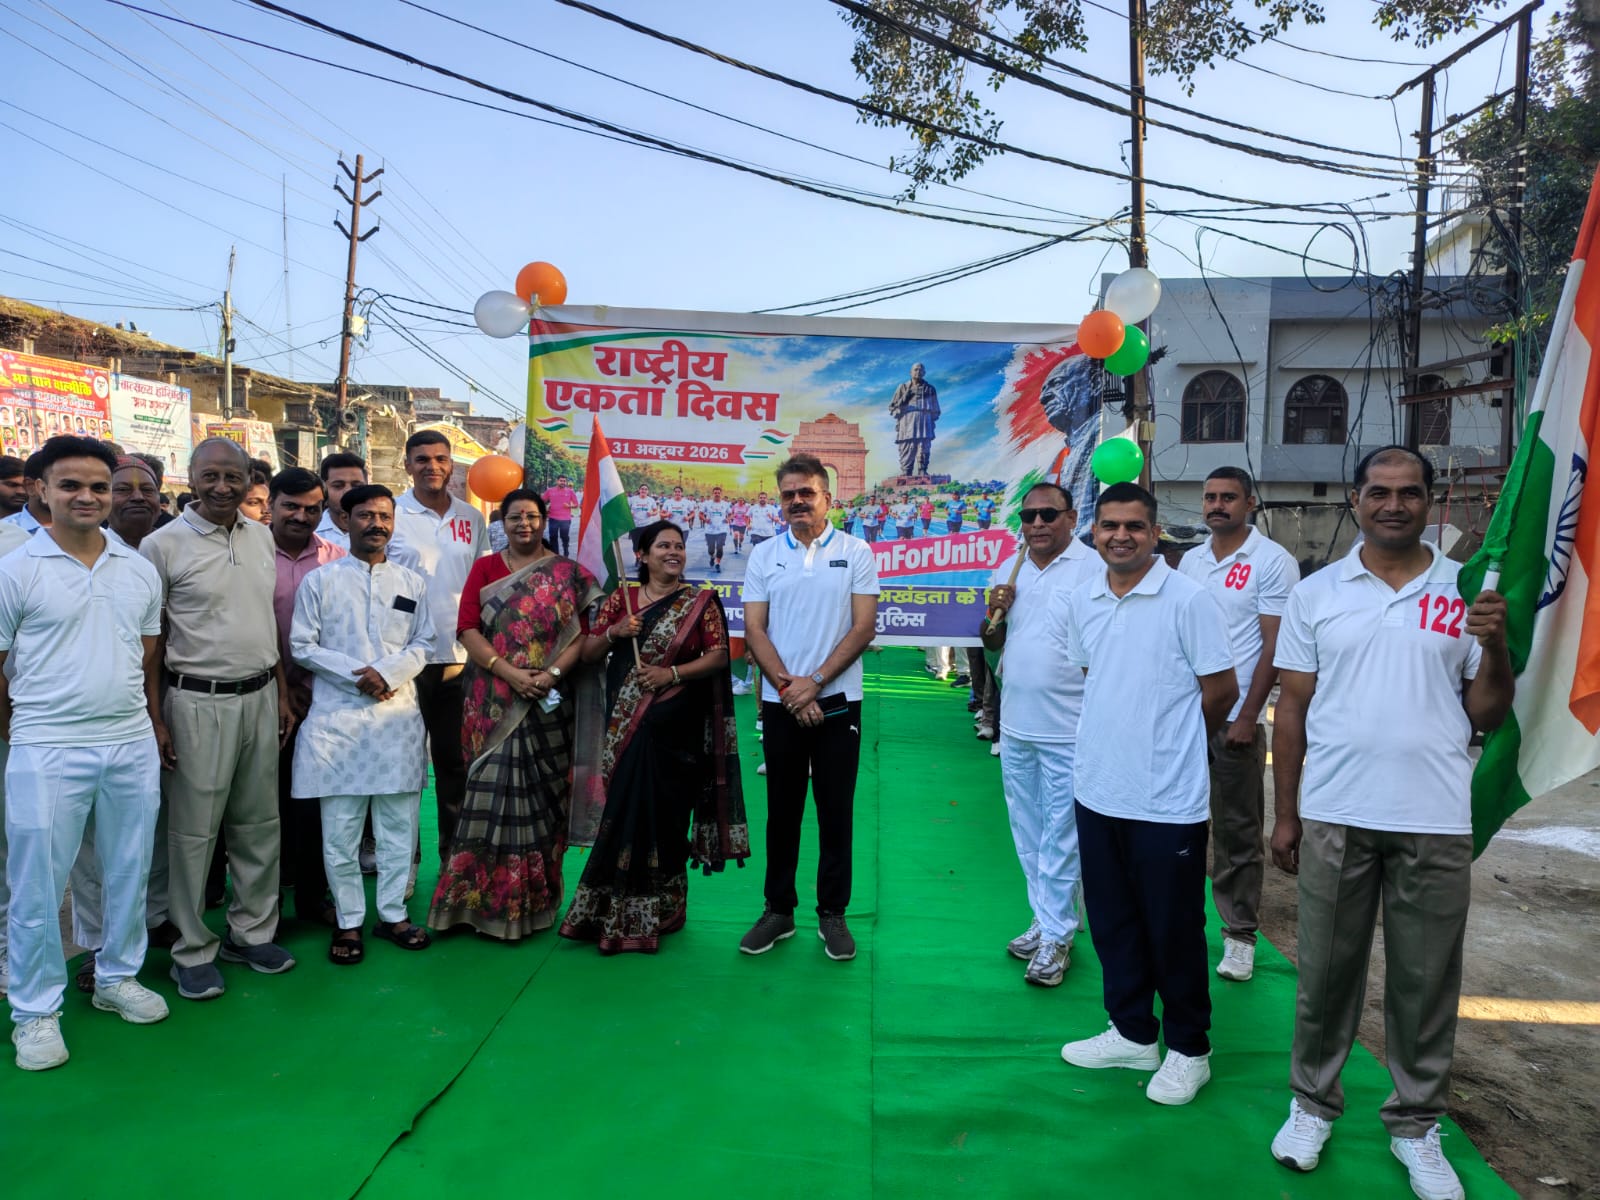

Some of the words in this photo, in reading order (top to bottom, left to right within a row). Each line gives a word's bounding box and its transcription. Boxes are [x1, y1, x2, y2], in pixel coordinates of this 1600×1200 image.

[594, 340, 728, 384] राष्ट्रीय
[544, 379, 665, 416] एकता
[675, 379, 780, 421] दिवस
[612, 441, 630, 454] 31
[635, 443, 685, 459] अक्टूबर
[689, 445, 729, 459] 2026
[449, 518, 472, 544] 145
[875, 535, 1003, 572] nForUnity
[1225, 562, 1251, 590] 69
[955, 587, 978, 605] के
[1418, 593, 1465, 639] 122
